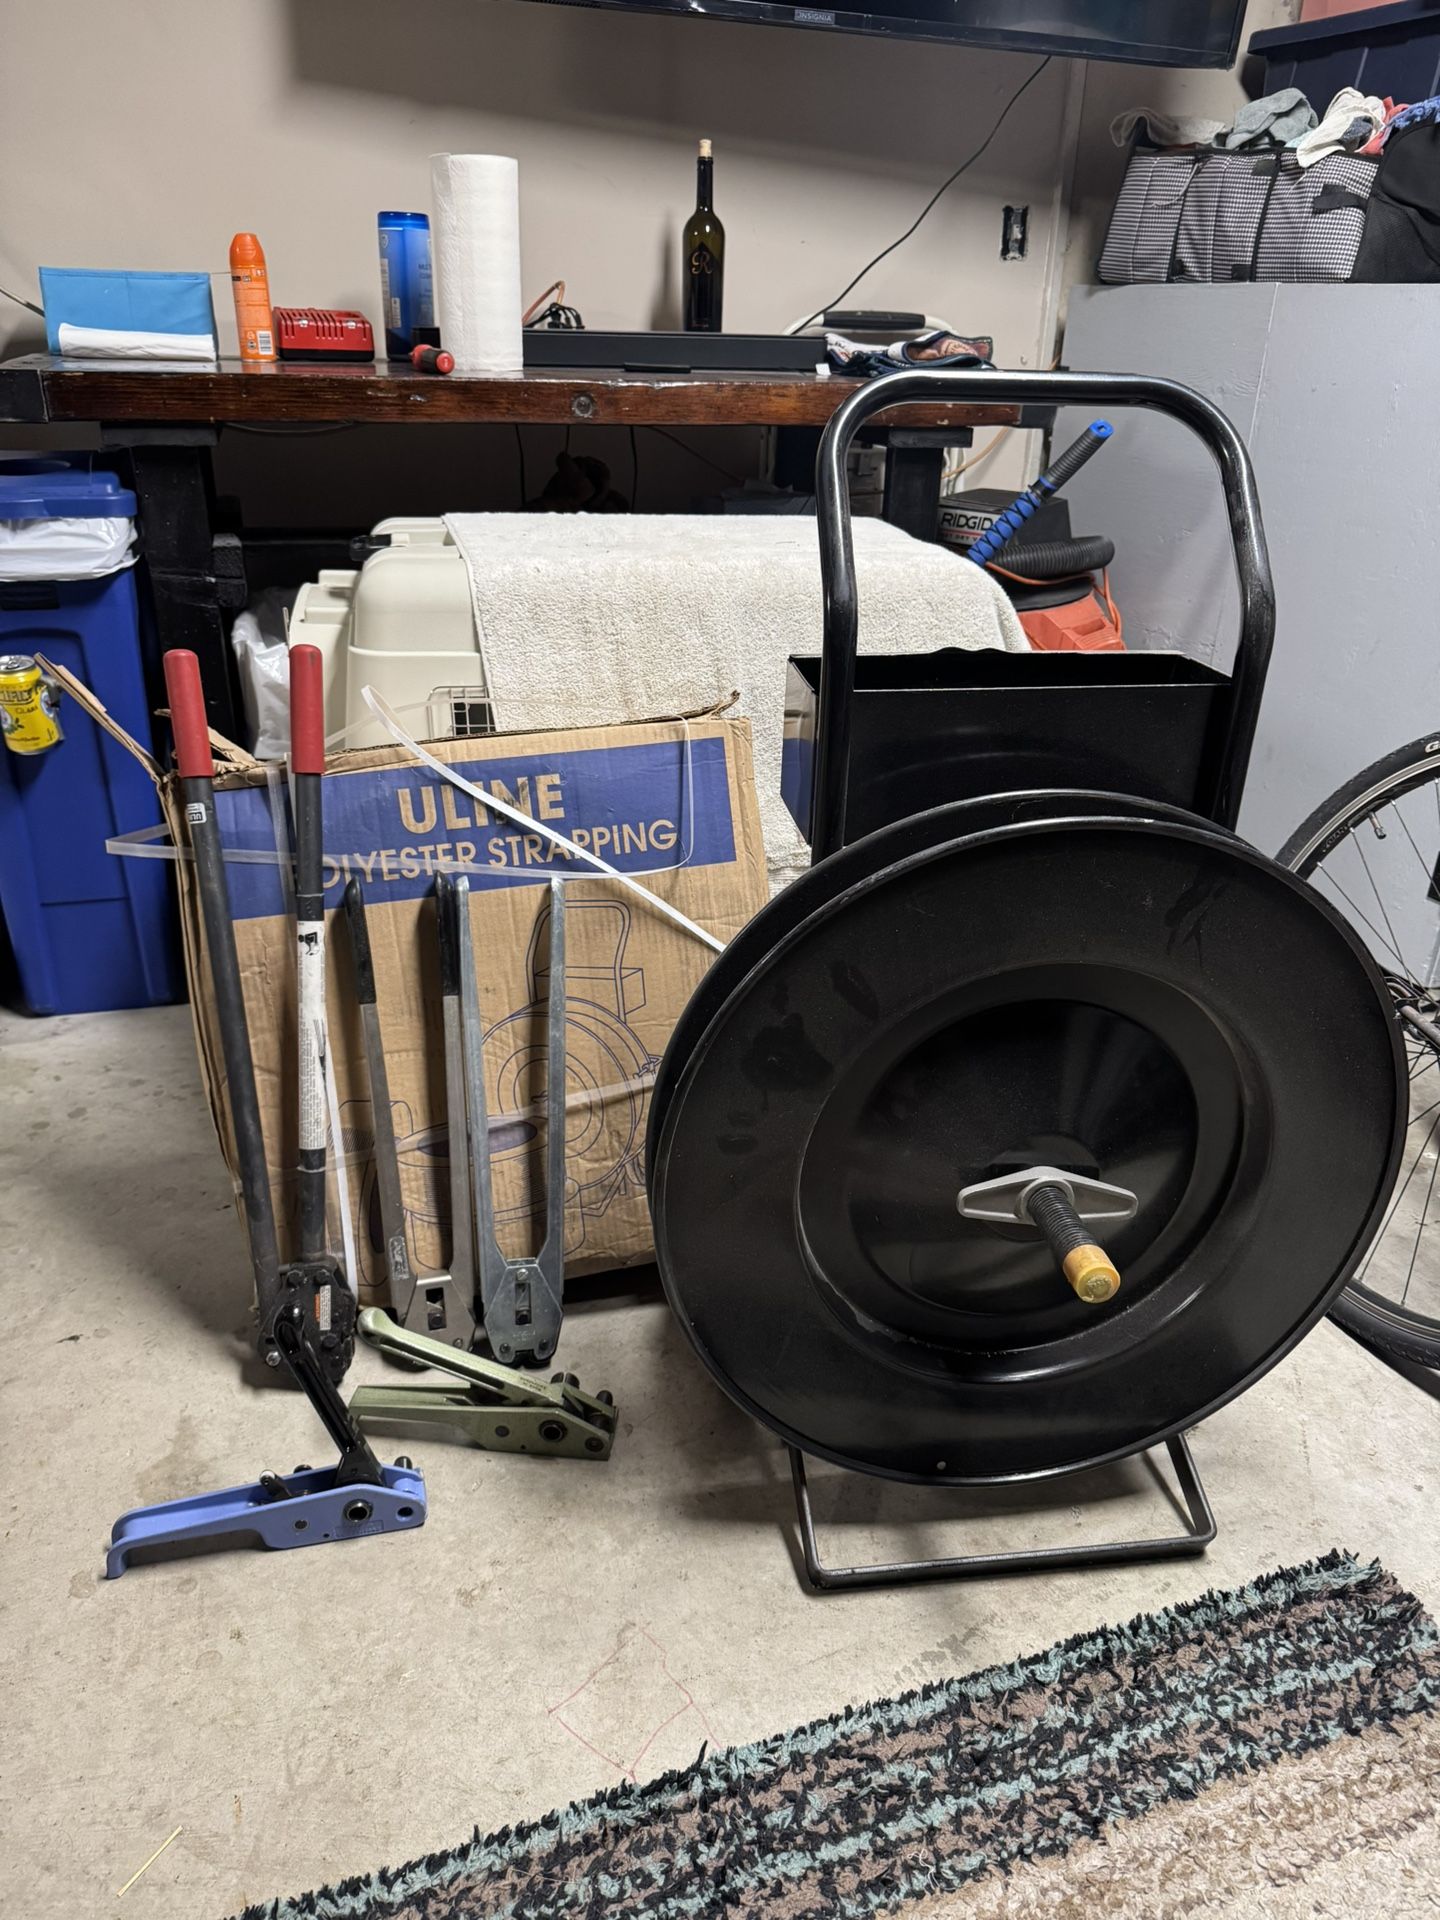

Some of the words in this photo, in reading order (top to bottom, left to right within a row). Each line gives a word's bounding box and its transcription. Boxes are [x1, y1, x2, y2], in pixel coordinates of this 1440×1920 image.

[799, 11, 832, 22] INSIGNIA
[941, 512, 993, 531] RIDGID
[397, 773, 565, 834] ULINE
[487, 818, 677, 867] STRAPPING
